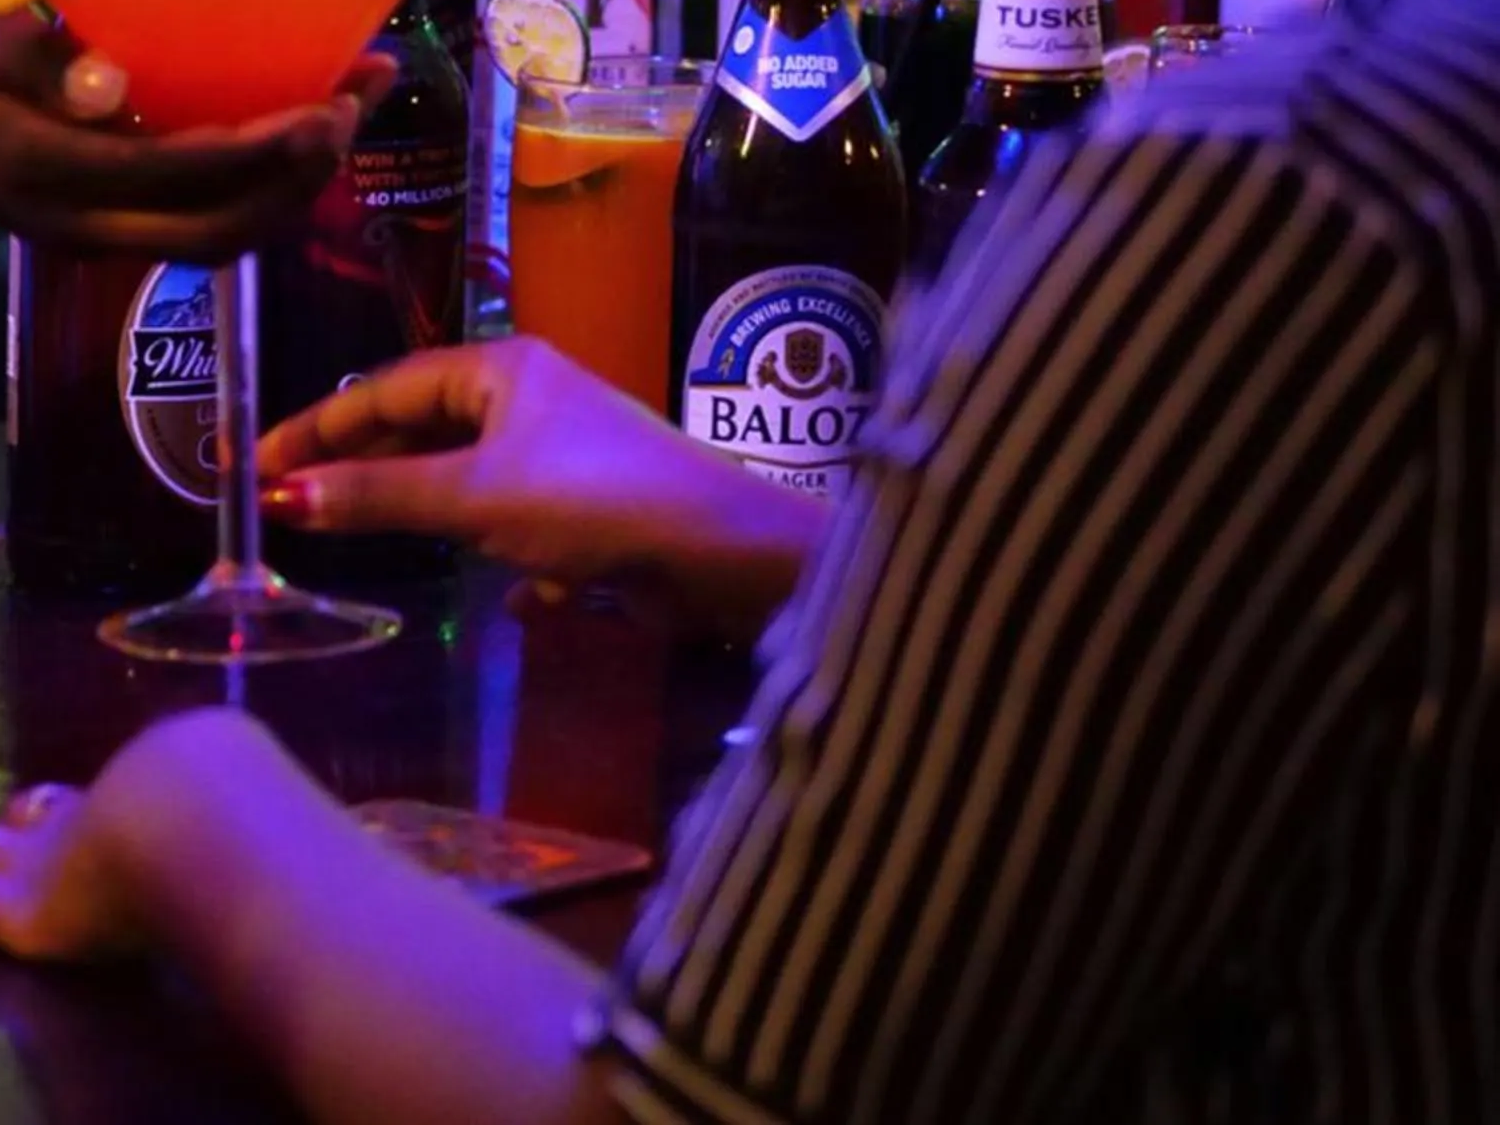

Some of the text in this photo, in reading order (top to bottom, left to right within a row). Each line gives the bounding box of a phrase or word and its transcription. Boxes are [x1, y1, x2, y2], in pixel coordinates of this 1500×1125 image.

[757, 55, 839, 74] NO ADDED
[771, 73, 827, 89] SUGAR
[354, 153, 394, 168] WIN
[366, 191, 390, 206] 40
[730, 298, 792, 347] BREWING
[797, 296, 872, 350] EXCELLENCE
